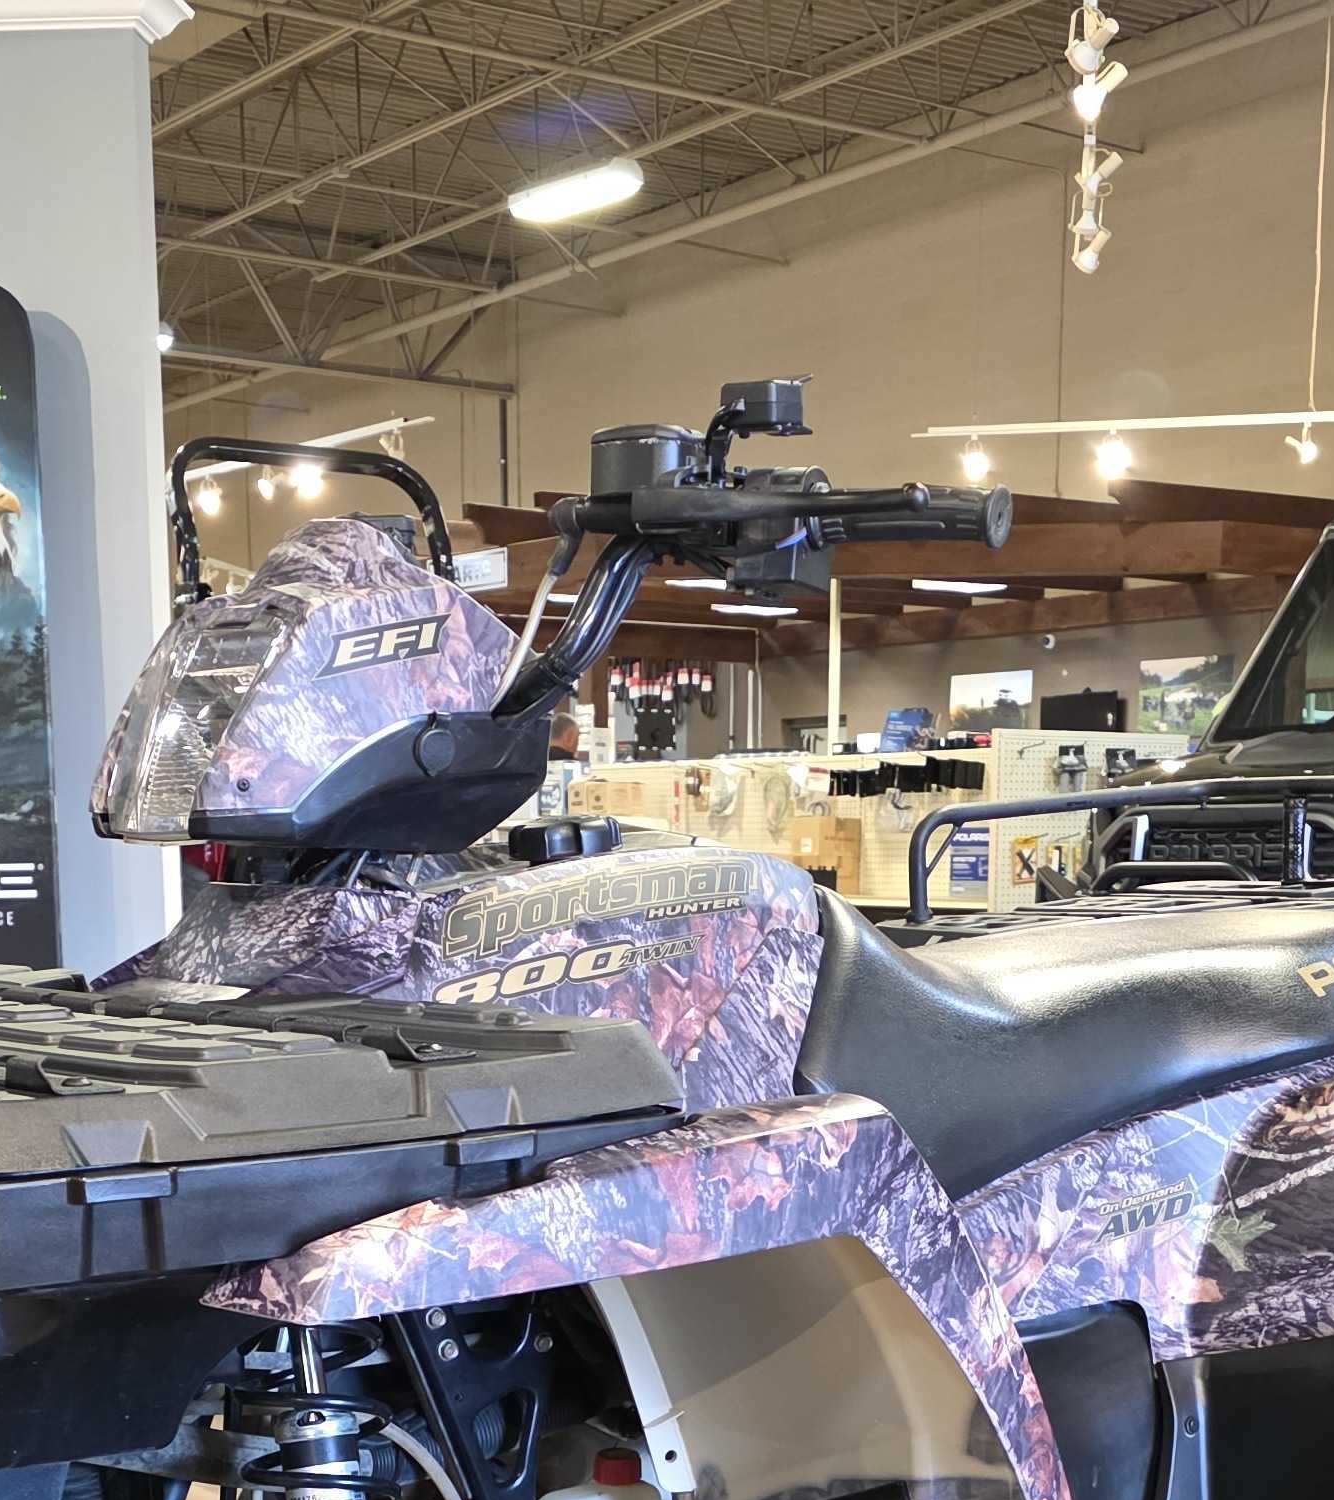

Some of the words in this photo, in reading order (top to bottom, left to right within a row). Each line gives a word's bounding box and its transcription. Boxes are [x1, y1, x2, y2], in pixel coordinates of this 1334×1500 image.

[332, 622, 437, 668] EFI
[442, 861, 751, 961] Sportsman
[648, 897, 743, 921] HUNTER
[619, 934, 705, 967] TWIN
[1091, 1192, 1194, 1244] AWD
[1099, 1203, 1119, 1216] On
[1122, 1180, 1186, 1209] Demand
